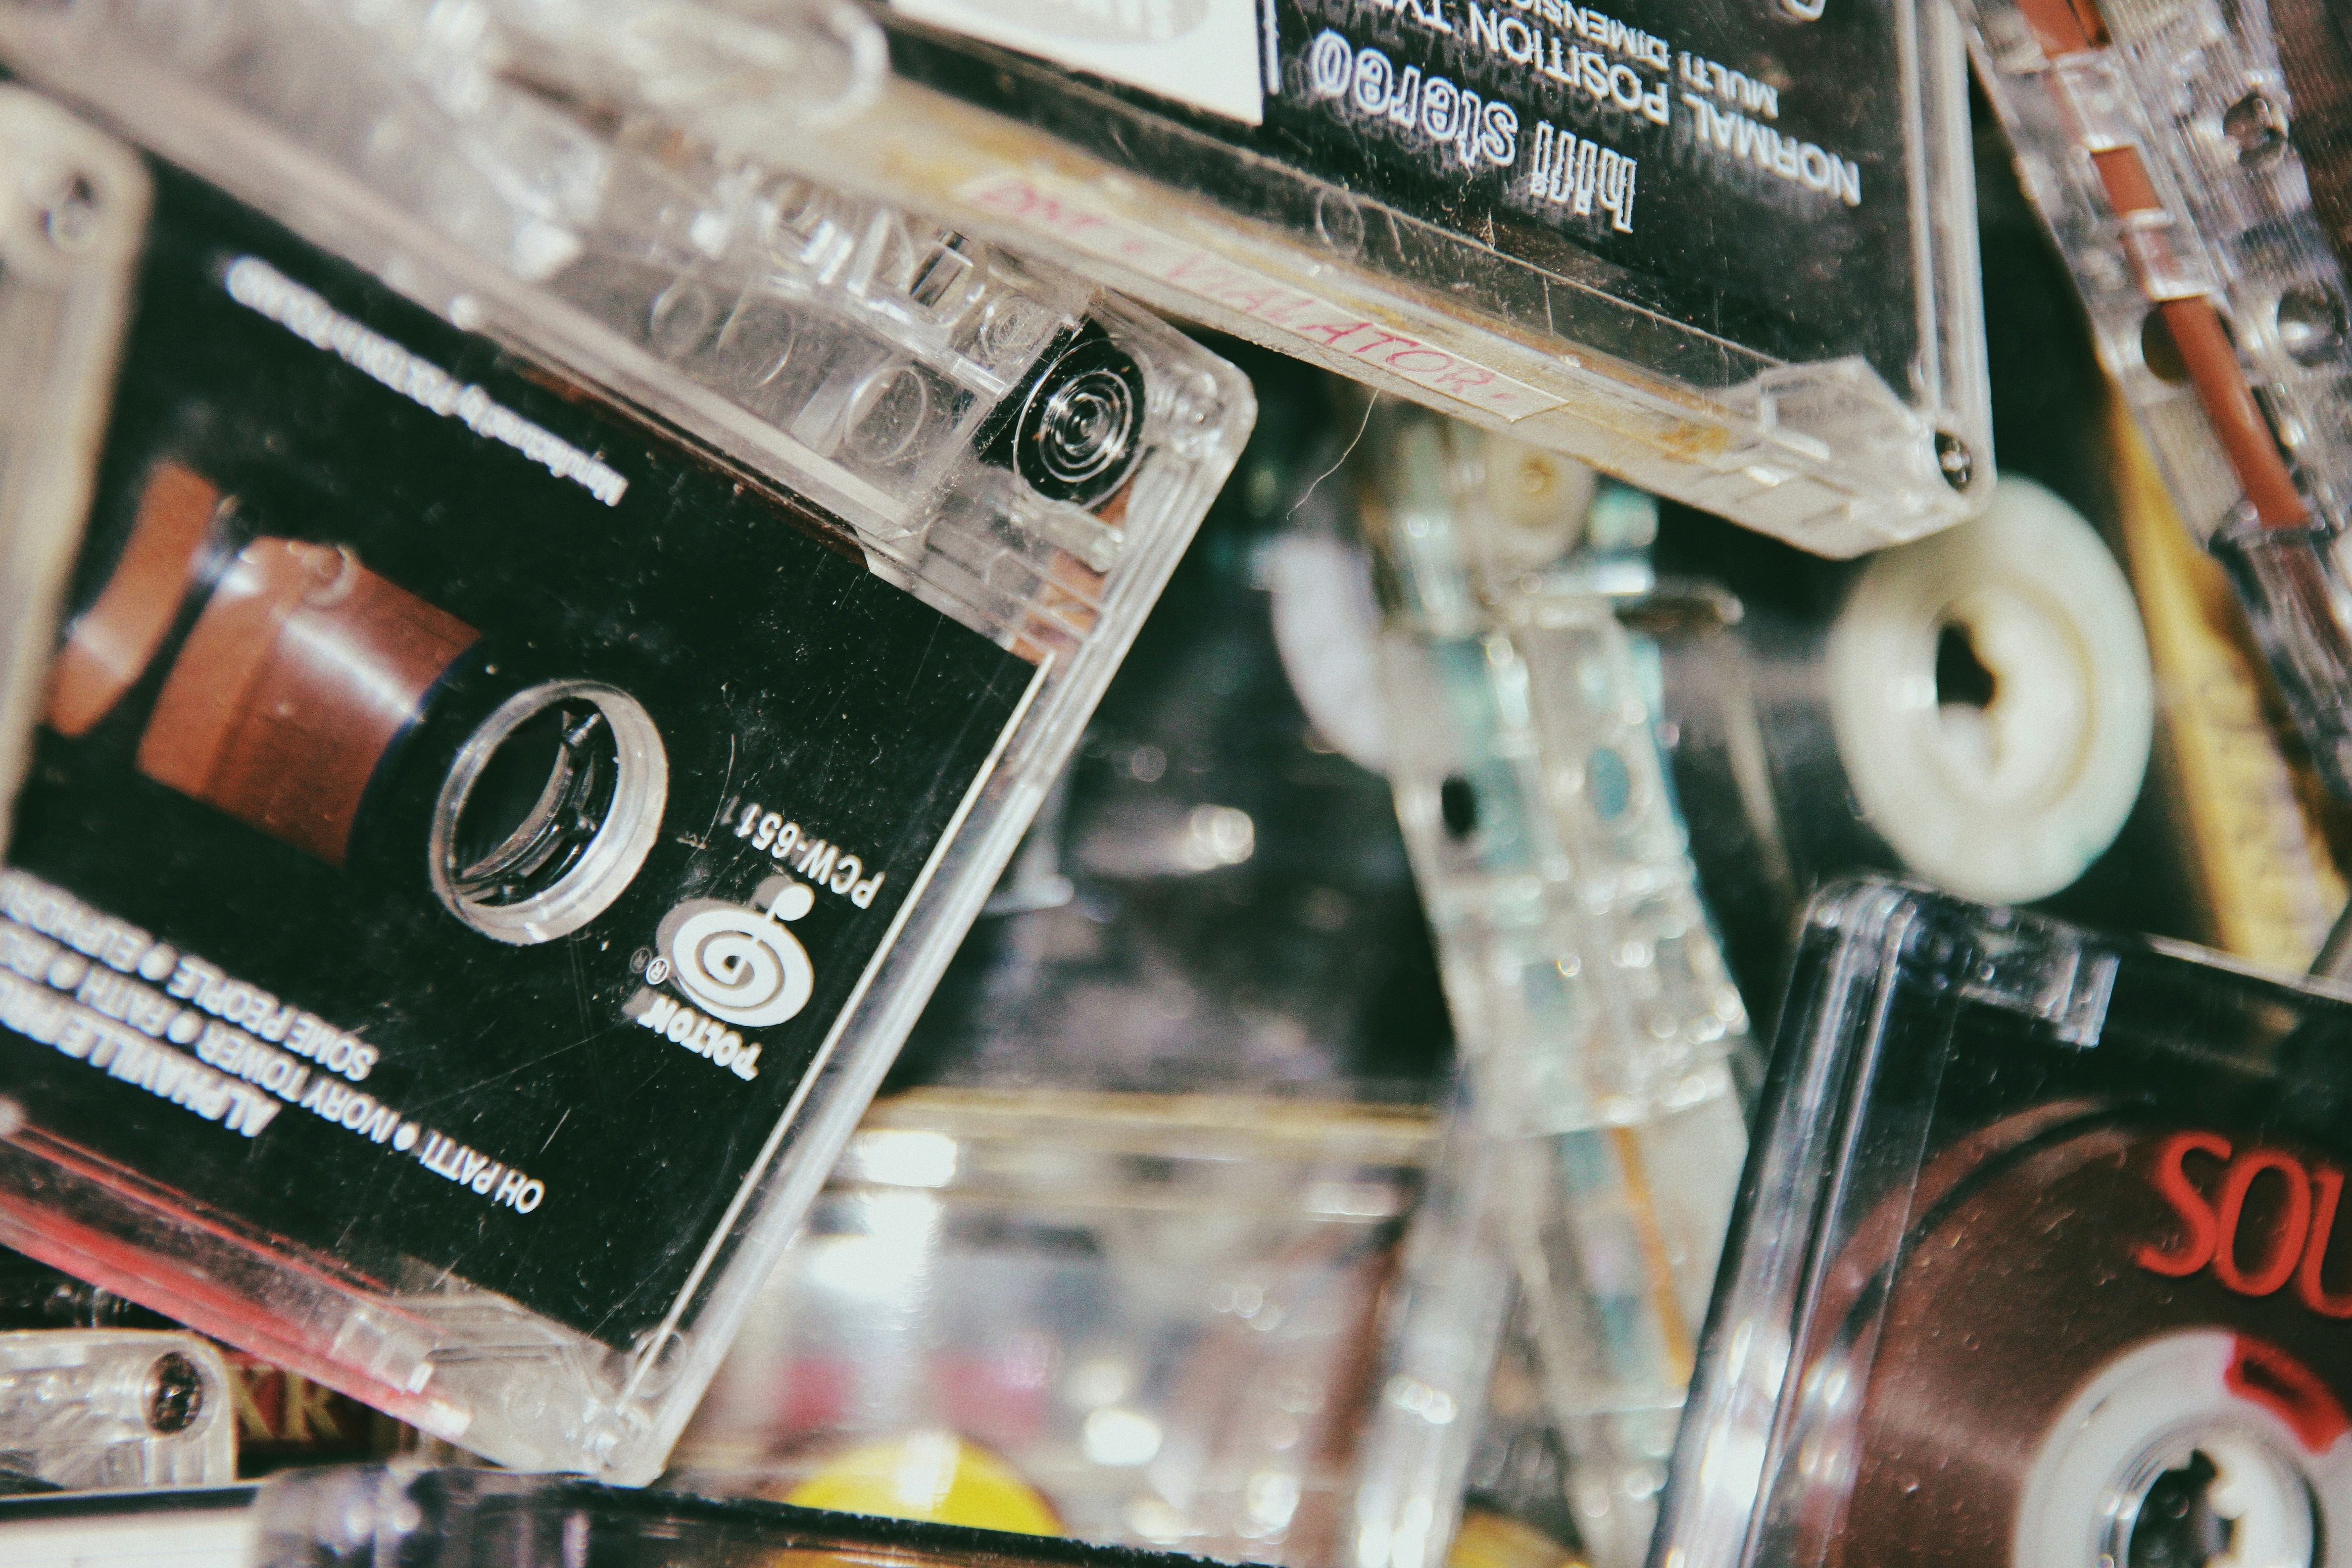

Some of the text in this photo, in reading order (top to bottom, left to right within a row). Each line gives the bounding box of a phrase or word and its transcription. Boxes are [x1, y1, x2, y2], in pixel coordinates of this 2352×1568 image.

[1311, 28, 1519, 167] stereo
[1374, 0, 1862, 207] NORMAL POSITION TY
[1679, 50, 1779, 119] MULTI
[735, 802, 885, 910] PCW-651
[75, 960, 182, 1039] FAITH
[165, 953, 298, 1044] PEOPLE
[637, 994, 763, 1082] POLTON
[53, 992, 282, 1137] ALPHAVILLE
[195, 1018, 311, 1103] TOWER
[279, 1011, 380, 1083] SOME
[302, 1075, 402, 1146] IVORY
[419, 1128, 503, 1193] PATTI
[494, 1170, 546, 1214] OH
